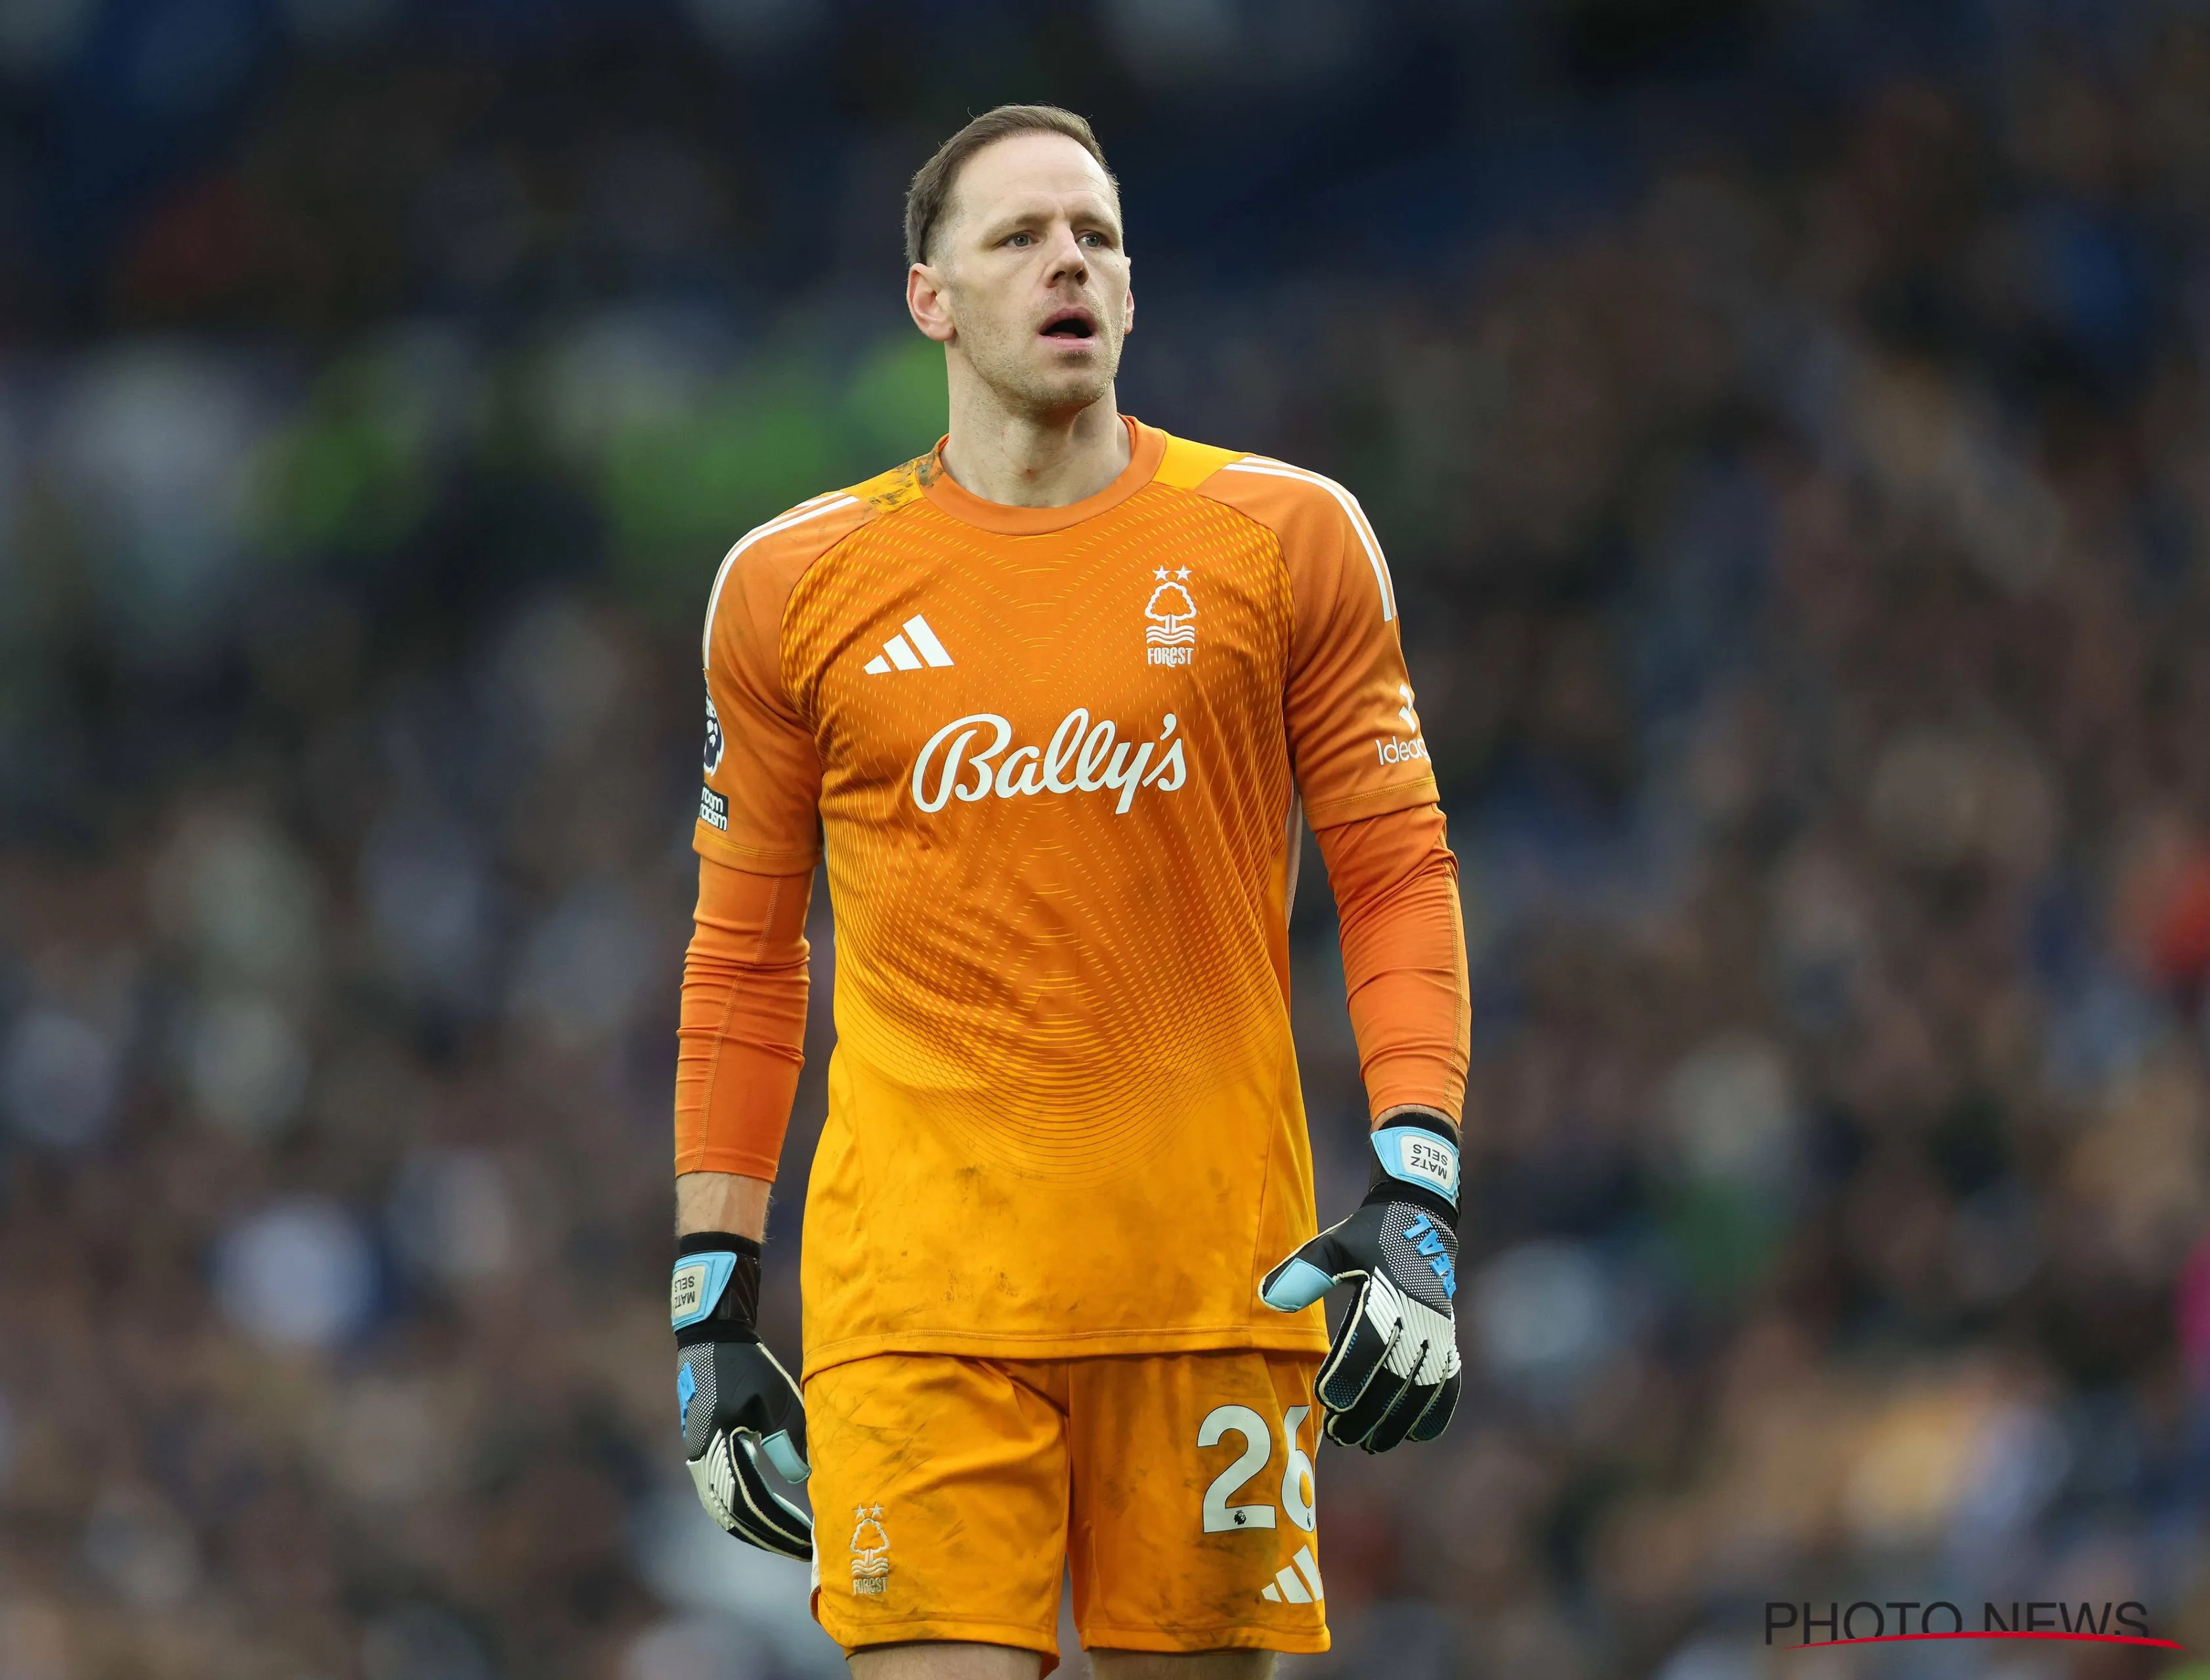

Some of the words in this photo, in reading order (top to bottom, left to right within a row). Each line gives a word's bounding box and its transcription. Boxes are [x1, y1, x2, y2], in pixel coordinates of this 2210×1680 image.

[912, 707, 1186, 814] Bally's
[1412, 1144, 1448, 1166] SELS
[1411, 1156, 1447, 1179] MATZ
[674, 1276, 694, 1293] SELS
[675, 1291, 695, 1309] MATZ
[1197, 1404, 1316, 1533] 26
